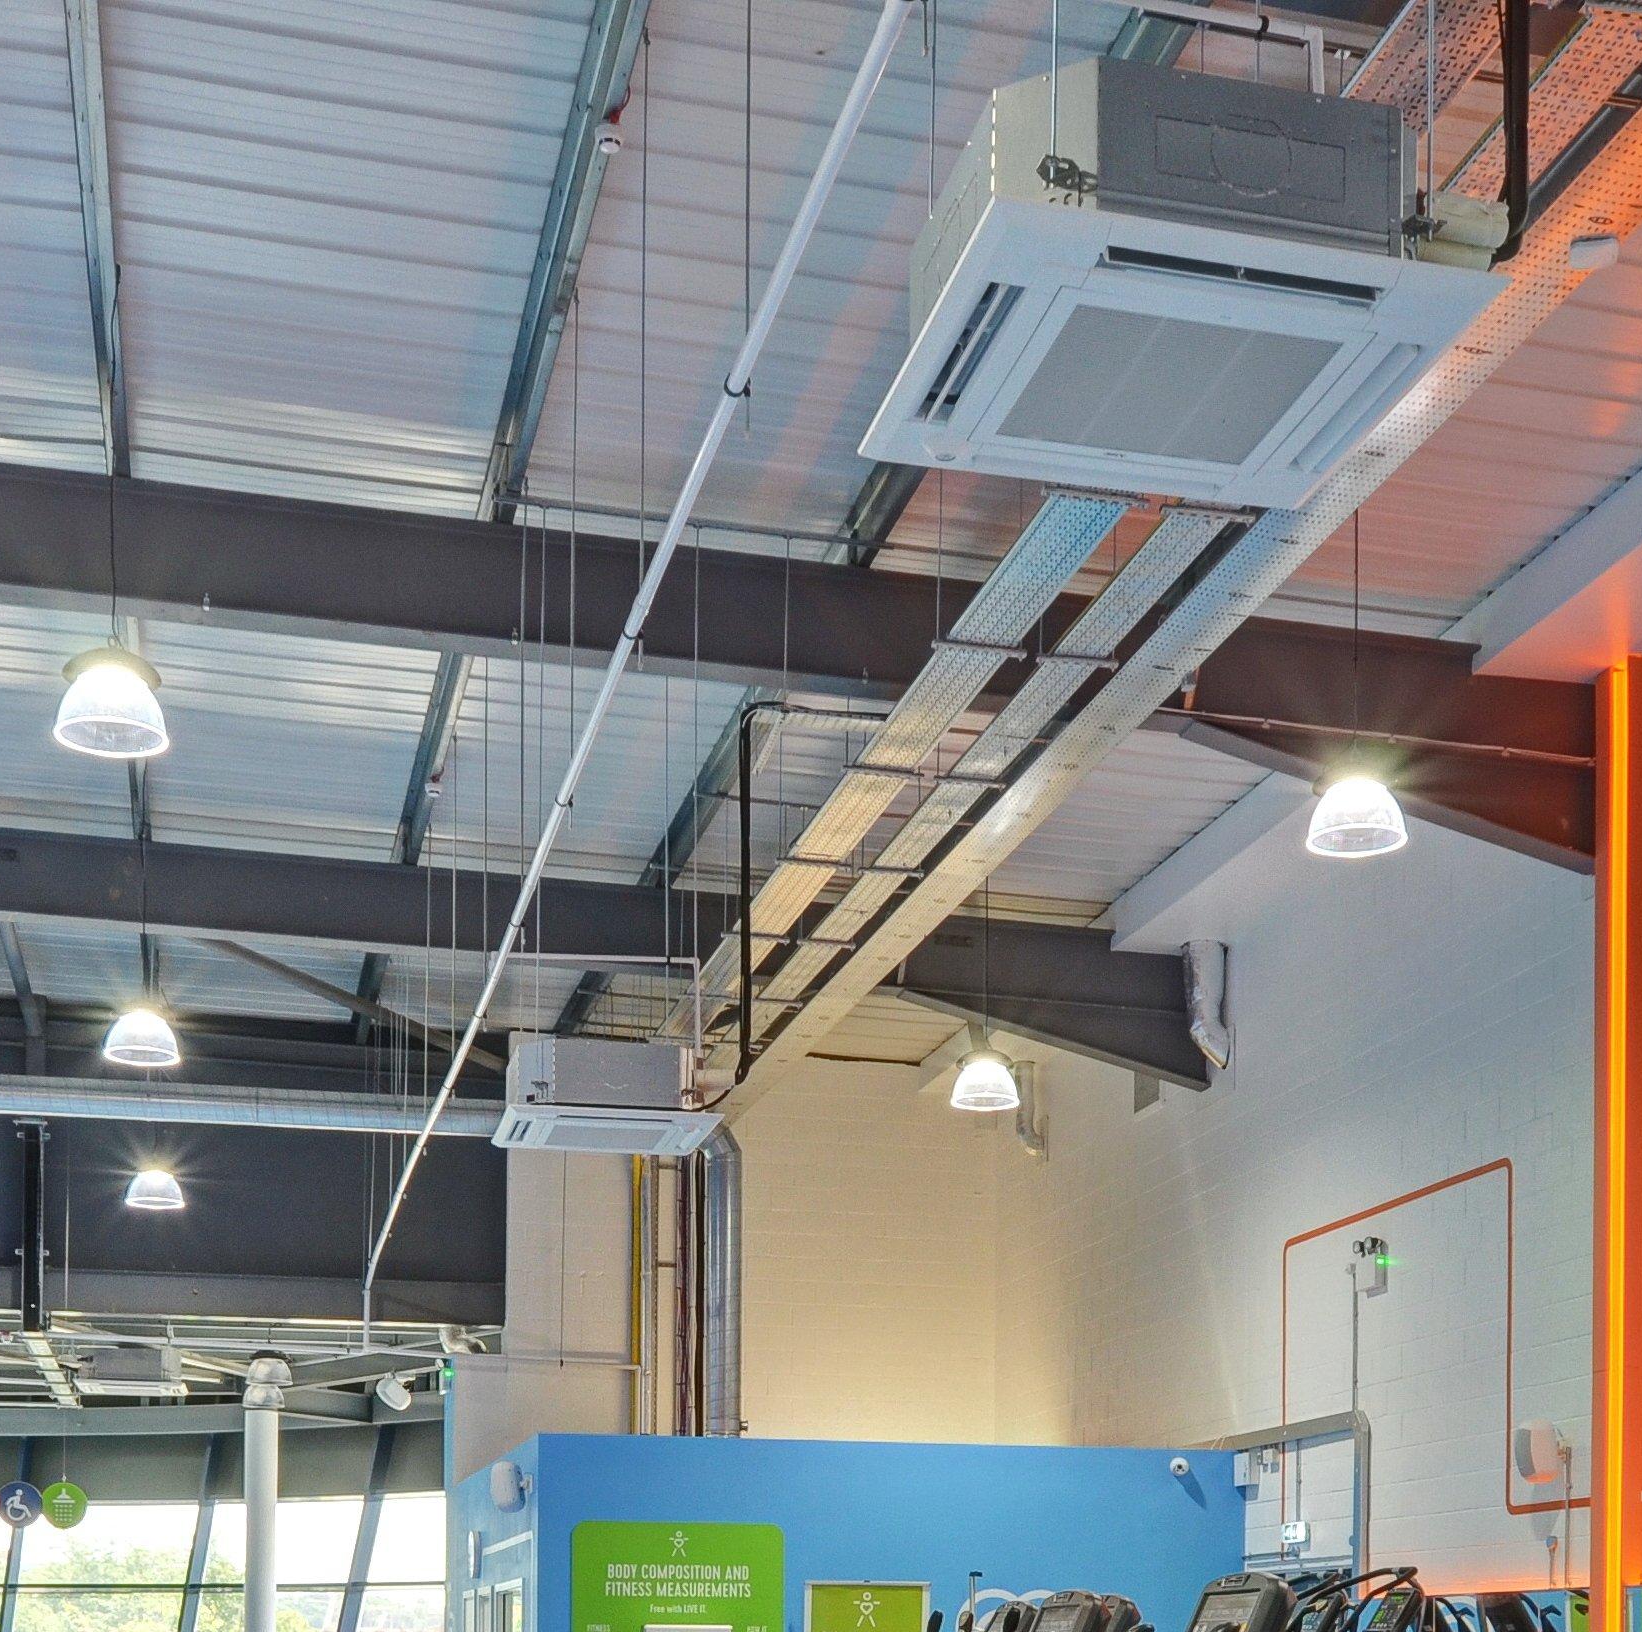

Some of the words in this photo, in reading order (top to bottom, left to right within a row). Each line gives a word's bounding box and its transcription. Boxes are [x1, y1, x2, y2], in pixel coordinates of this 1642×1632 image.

[607, 1564, 637, 1579] BODY
[641, 1564, 721, 1581] COMPOSITION
[725, 1565, 749, 1581] AND
[605, 1582, 652, 1597] FITNESS
[657, 1582, 751, 1598] MEASUREMENTS
[649, 1603, 665, 1613] Free
[666, 1604, 682, 1613] with
[683, 1604, 698, 1614] LIVE
[586, 1624, 611, 1632] FITNESS
[747, 1625, 760, 1632] HOW
